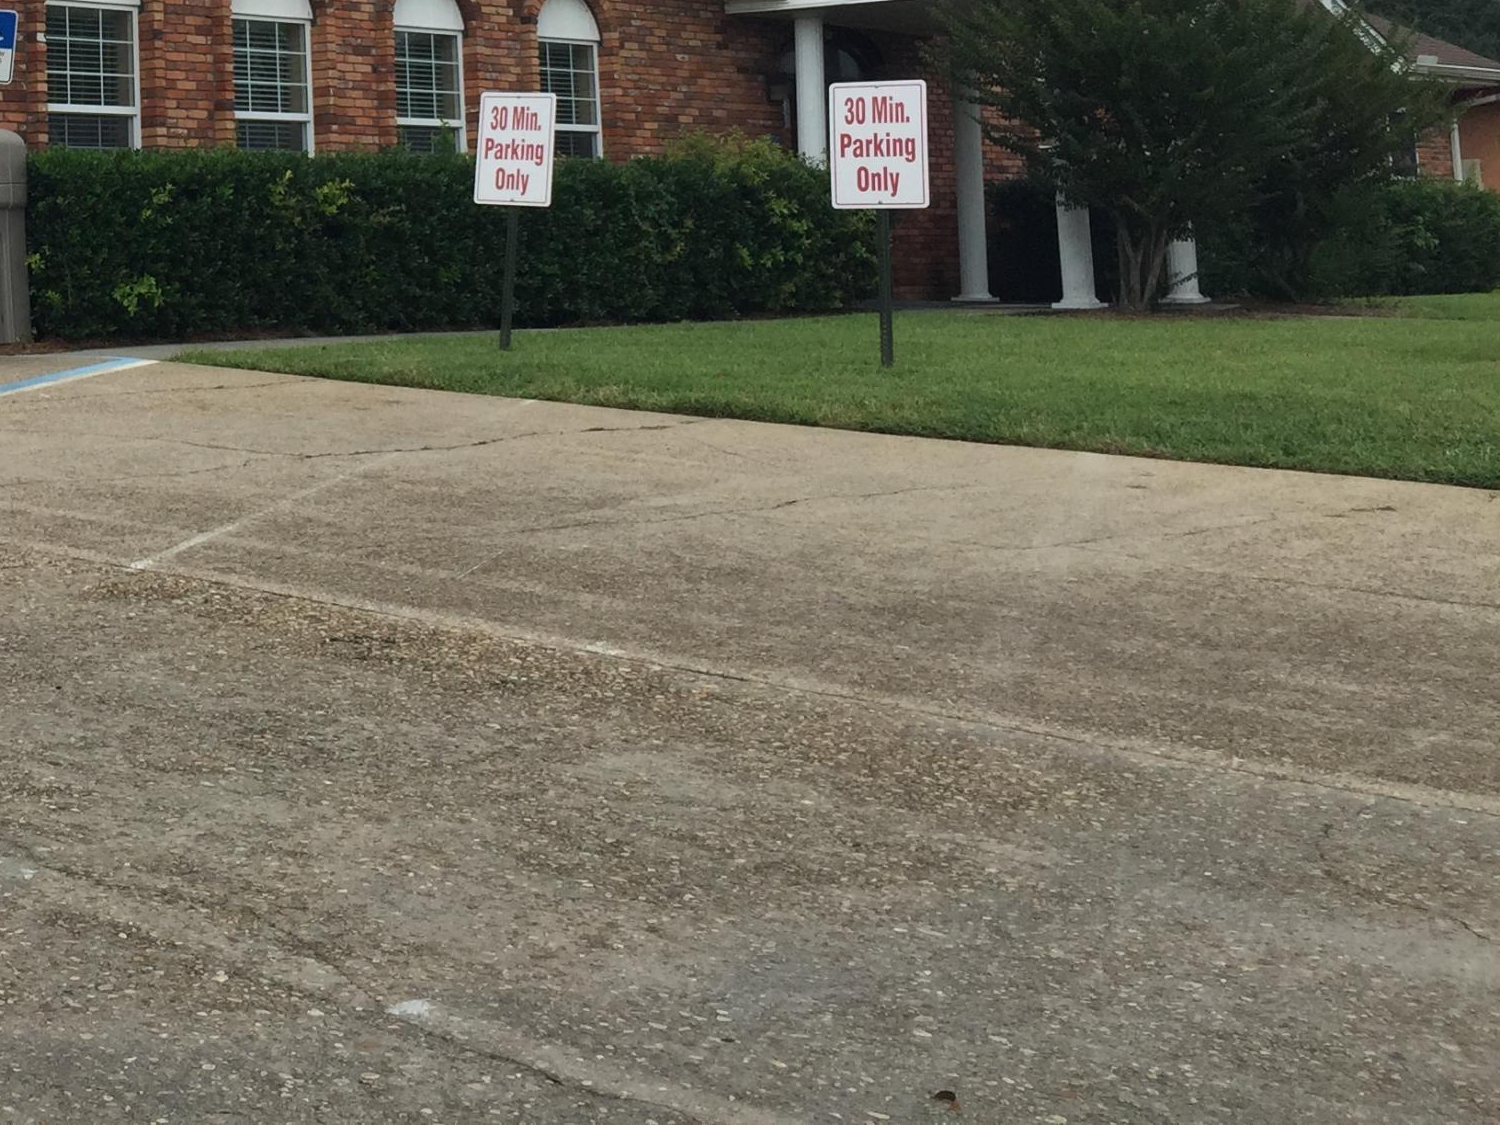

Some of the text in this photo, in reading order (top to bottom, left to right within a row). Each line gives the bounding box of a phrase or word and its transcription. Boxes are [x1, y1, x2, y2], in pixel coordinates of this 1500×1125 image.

[490, 105, 542, 131] 30 Min.
[844, 96, 910, 125] 30 Min.
[484, 137, 544, 166] Parking
[840, 132, 916, 163] Parking
[495, 167, 530, 195] Only
[857, 166, 900, 197] Only
